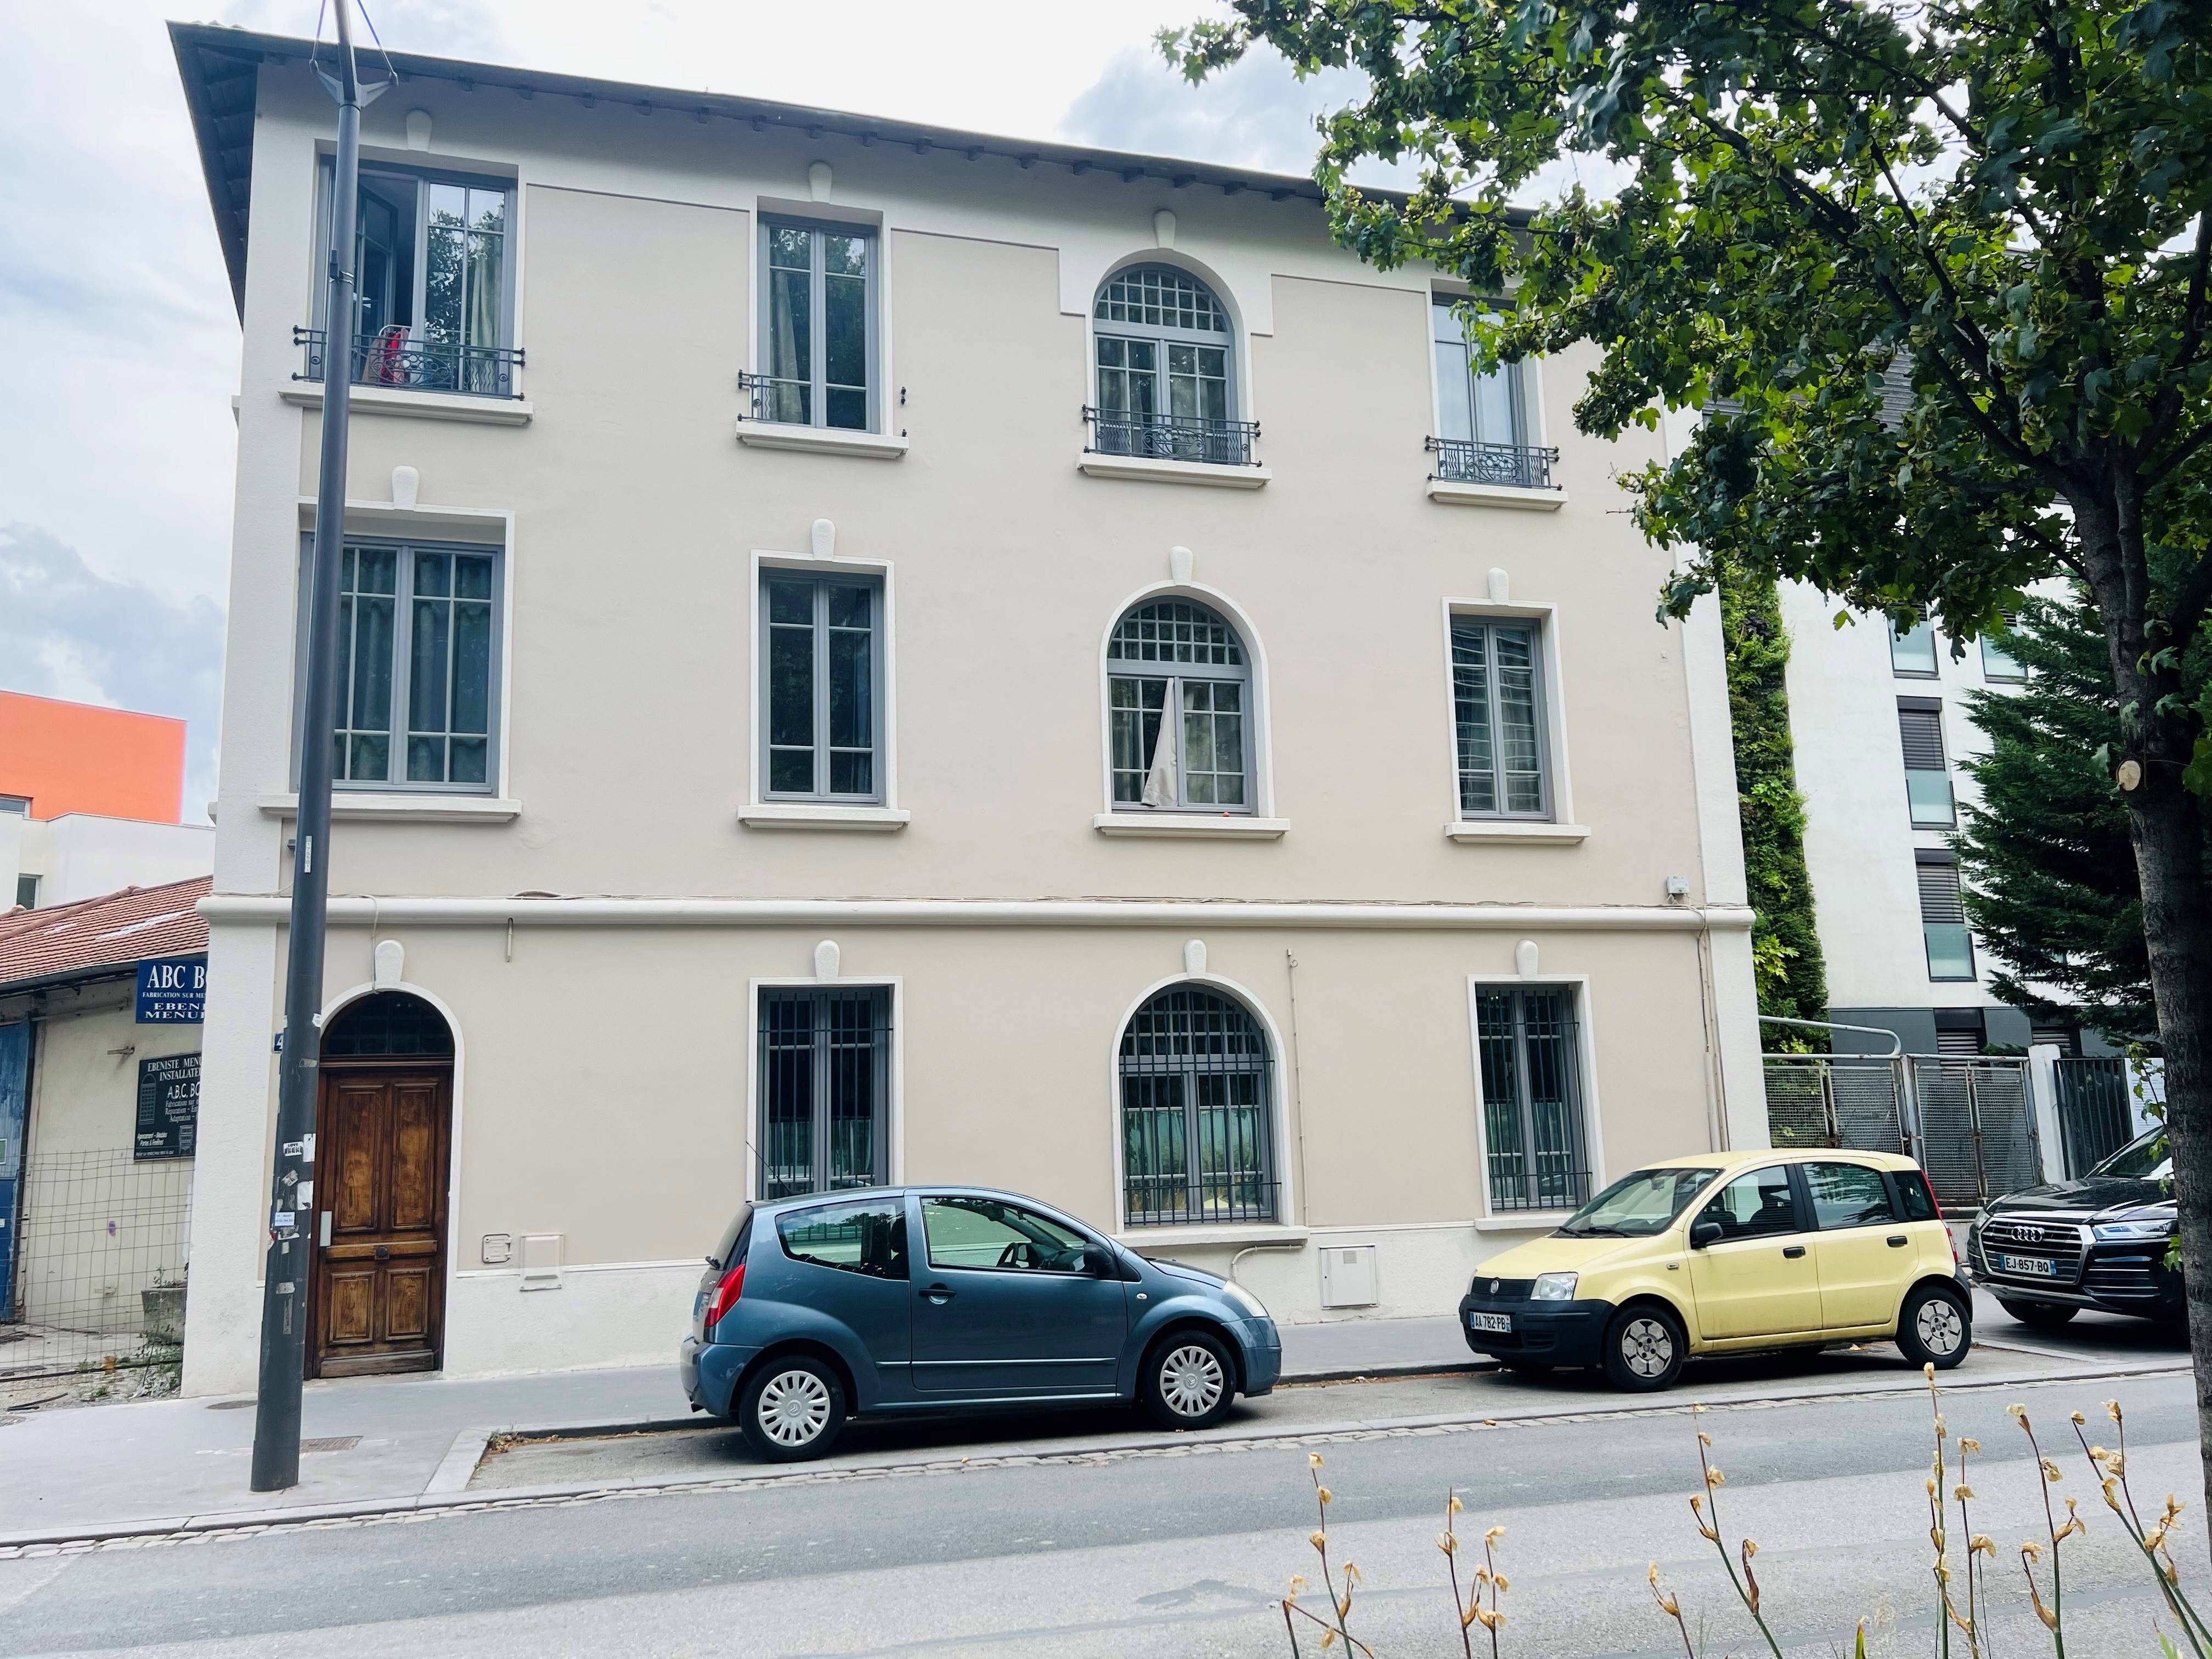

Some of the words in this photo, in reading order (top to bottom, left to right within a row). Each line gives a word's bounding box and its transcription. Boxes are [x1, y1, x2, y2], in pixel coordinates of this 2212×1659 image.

[147, 965, 186, 989] ABC
[193, 966, 207, 989] B
[148, 1059, 180, 1072] EBENISTE
[167, 1083, 188, 1099] A.B.C.
[2006, 1257, 2049, 1273] EJ-857-BQ
